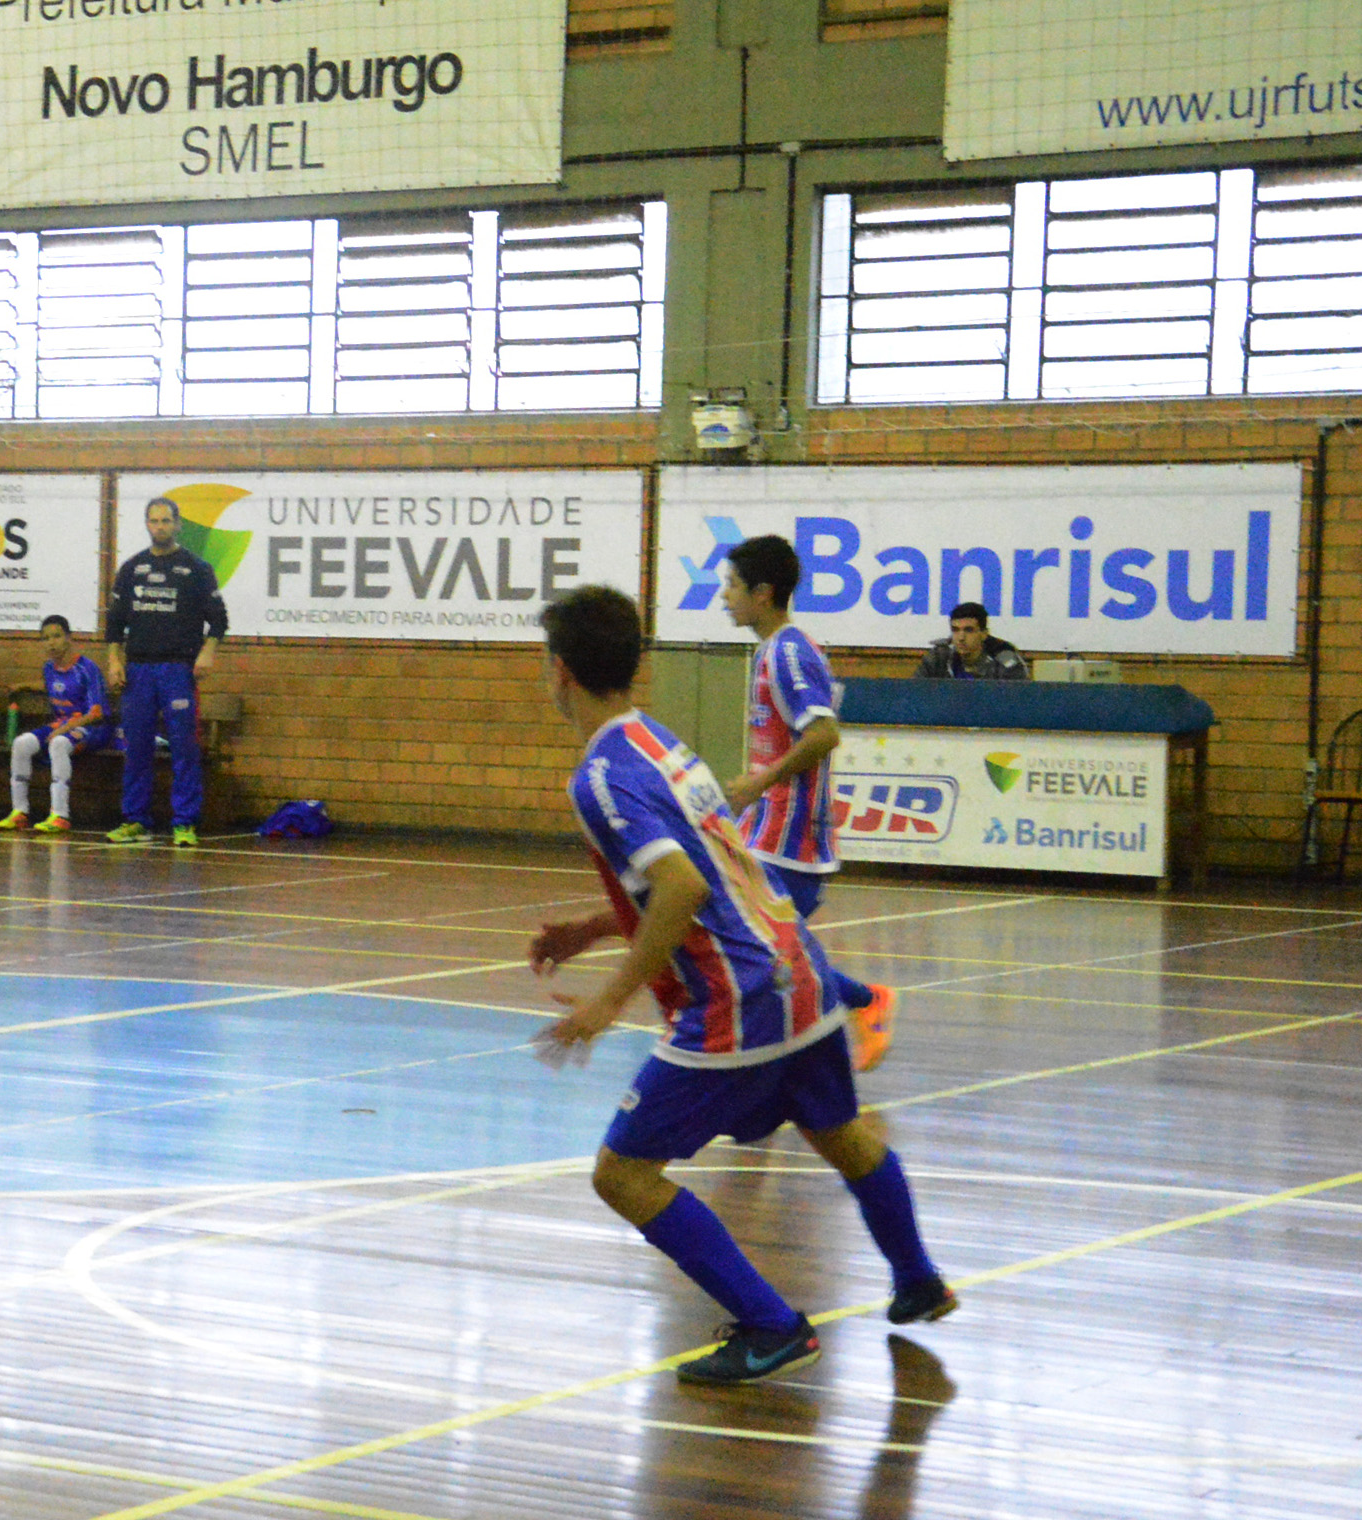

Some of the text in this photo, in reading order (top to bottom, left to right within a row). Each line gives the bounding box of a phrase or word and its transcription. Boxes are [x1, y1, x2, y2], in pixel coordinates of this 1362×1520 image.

[41, 48, 464, 118] Novo Hamburgo
[178, 121, 325, 176] SMEL
[268, 496, 583, 526] UNIVERSIDADE
[267, 536, 582, 601] FEEVALE
[793, 510, 1271, 622] Banrisul
[265, 608, 389, 626] CONHECIMENTO
[391, 609, 435, 626] PARA
[437, 611, 496, 628] INOVAR
[499, 612, 514, 628] O
[1026, 758, 1149, 773] UNIVERSIDADE
[1026, 771, 1148, 798] FEEVALE
[1016, 818, 1147, 851] Banrisul
